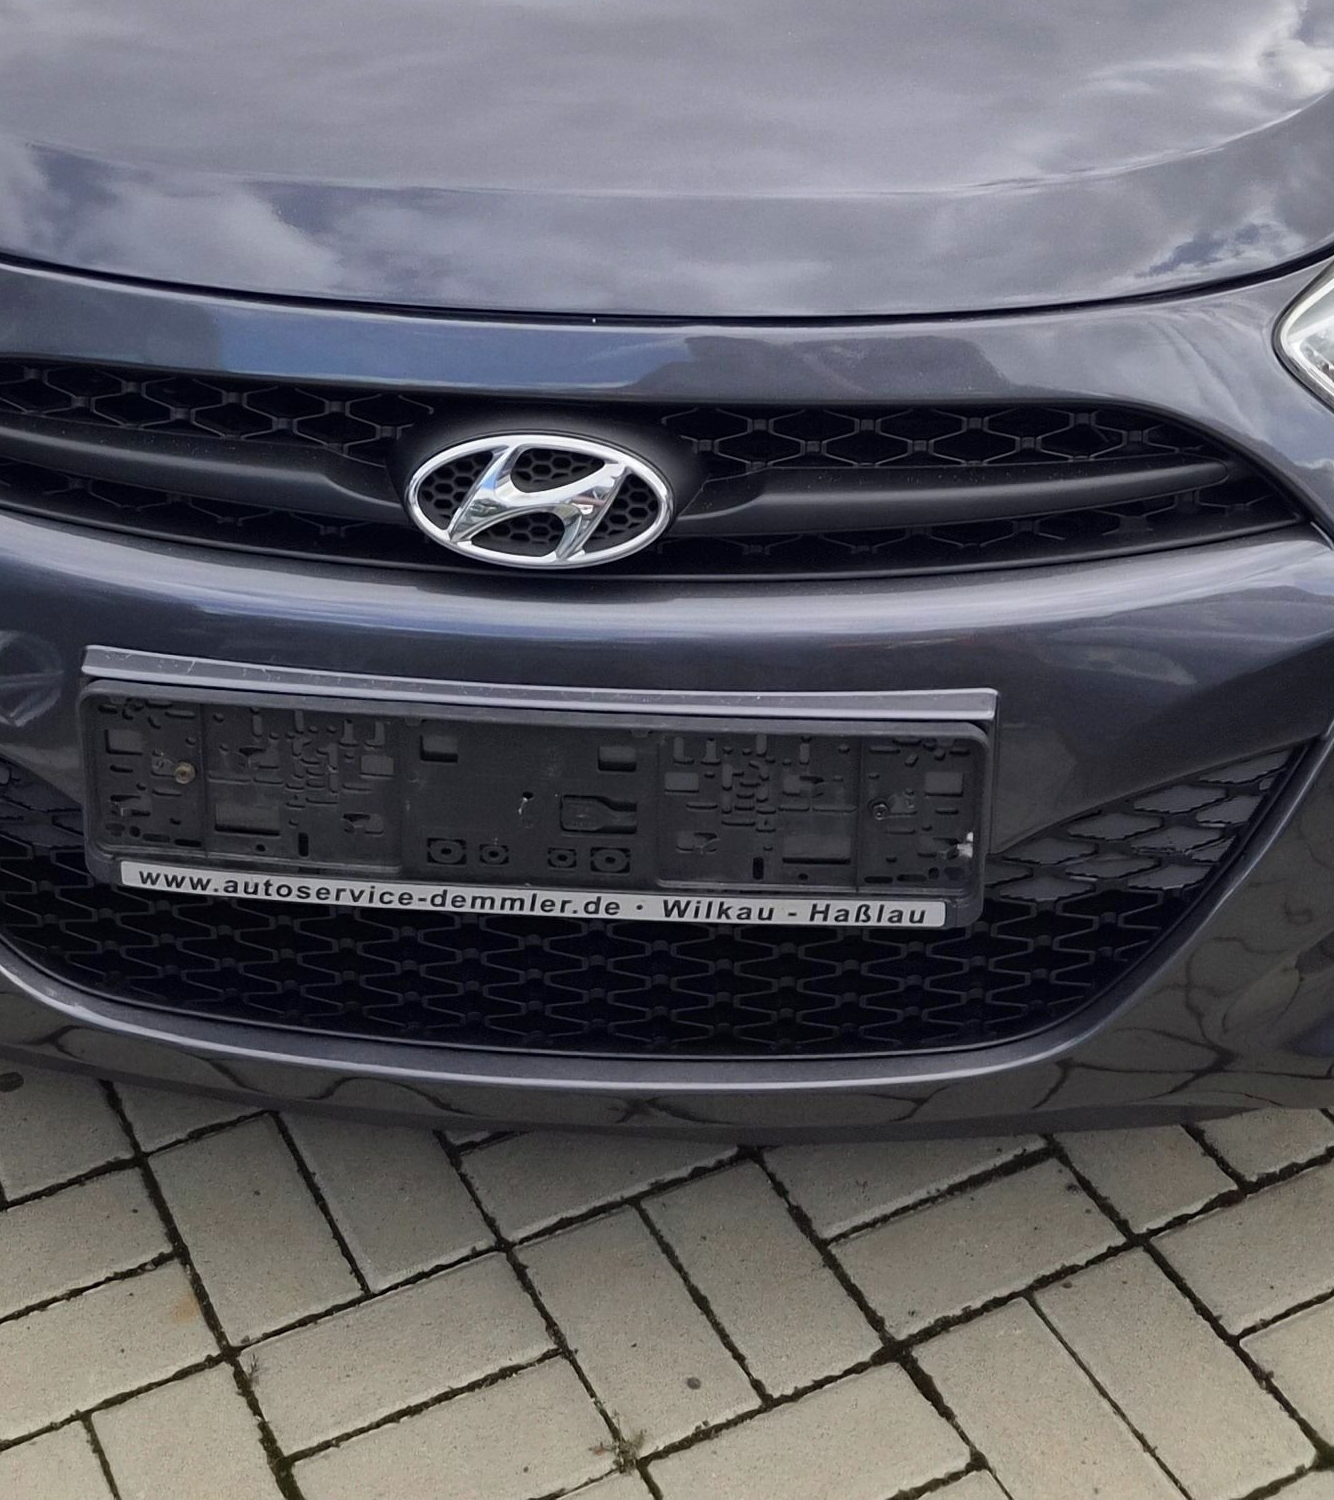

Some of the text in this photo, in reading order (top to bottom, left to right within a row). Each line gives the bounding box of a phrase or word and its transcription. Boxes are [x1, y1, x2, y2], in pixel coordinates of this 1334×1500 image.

[139, 870, 621, 917] www.autoservice-demmler.de
[662, 899, 774, 922] Wilkau
[809, 903, 927, 925] Haßlau
